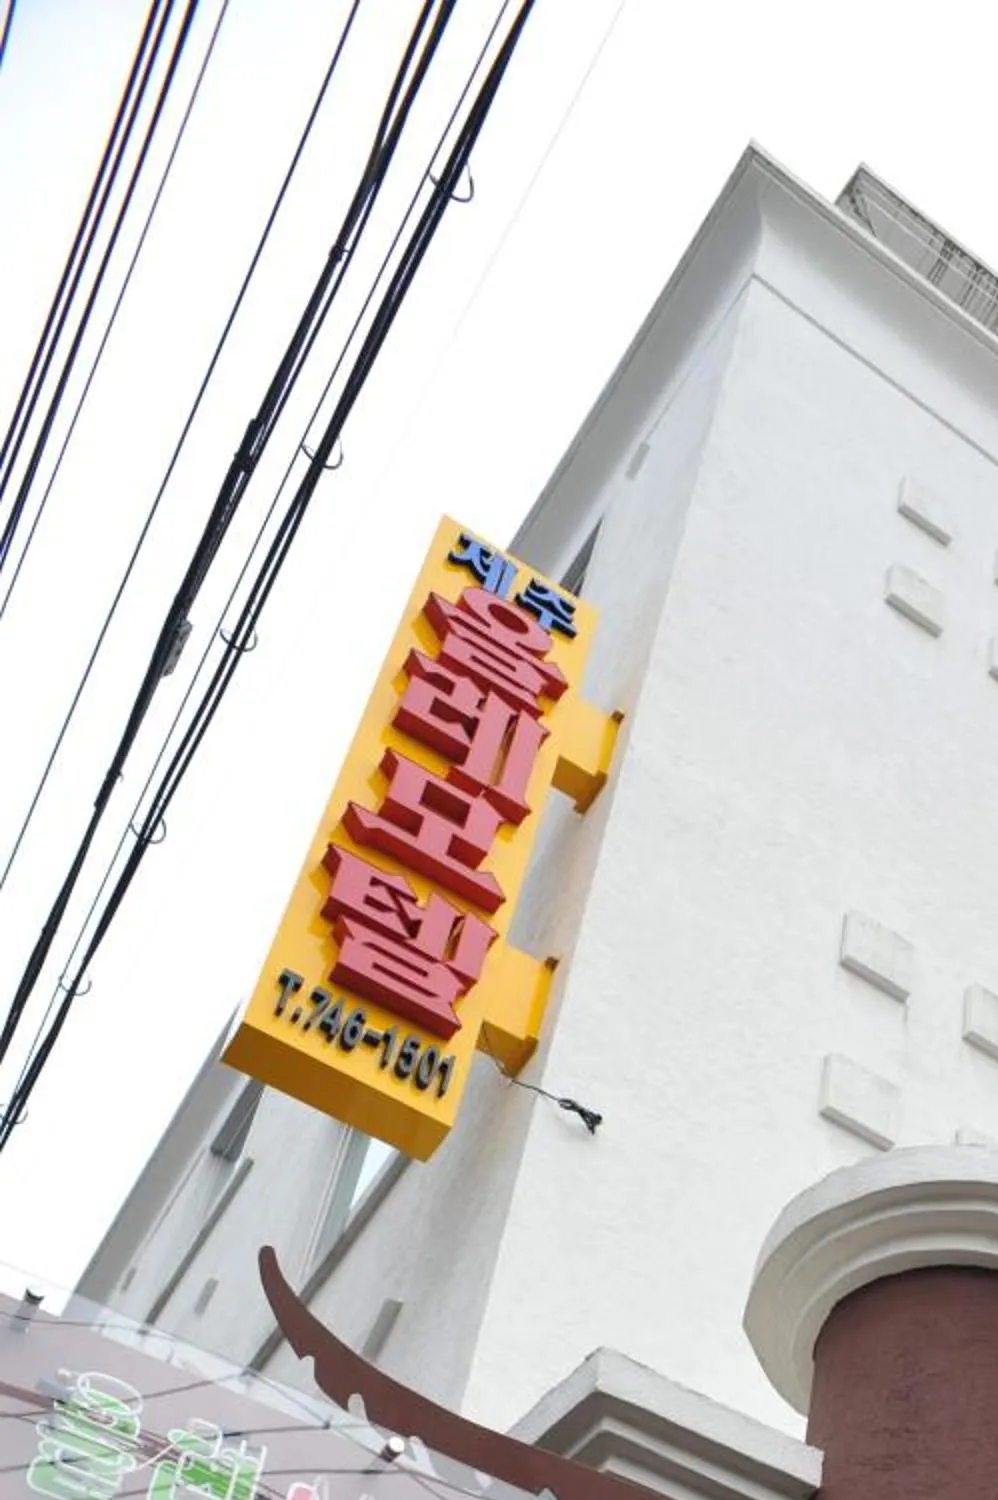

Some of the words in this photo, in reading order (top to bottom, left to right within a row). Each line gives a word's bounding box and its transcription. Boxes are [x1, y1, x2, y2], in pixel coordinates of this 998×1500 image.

[449, 532, 578, 638] 제주
[321, 586, 568, 1040] 올레모텔
[271, 967, 457, 1099] T.746-1501
